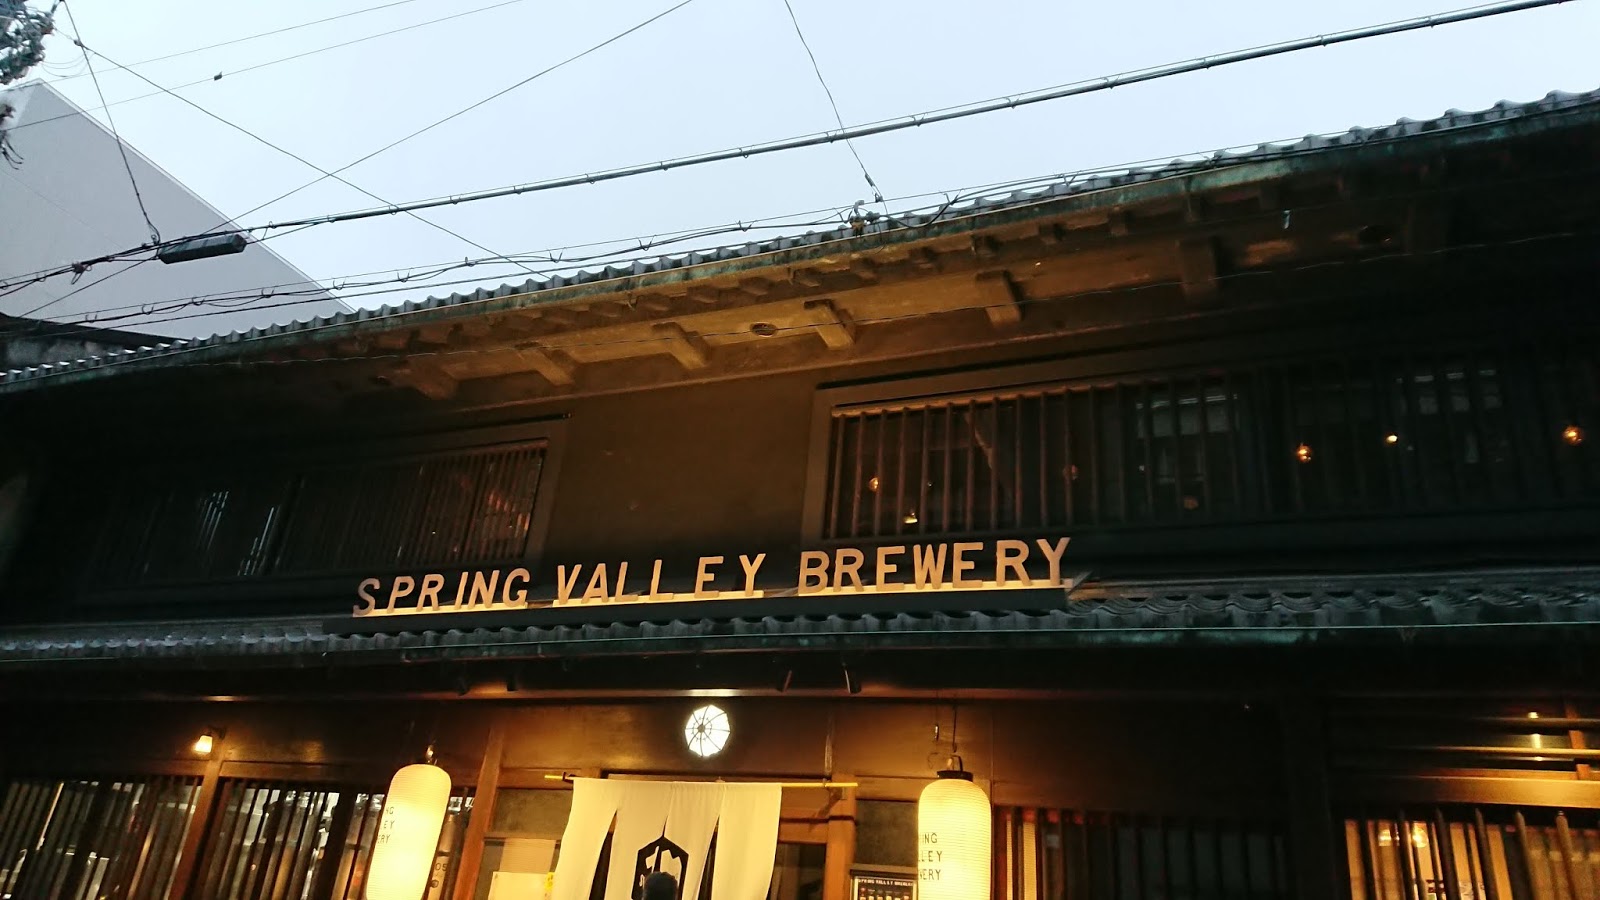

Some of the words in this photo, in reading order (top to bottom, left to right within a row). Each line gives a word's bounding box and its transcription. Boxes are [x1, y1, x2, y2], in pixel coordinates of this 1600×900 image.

[353, 568, 530, 617] SPRING
[556, 553, 766, 605] VALLEY
[798, 537, 1071, 594] BREWERY
